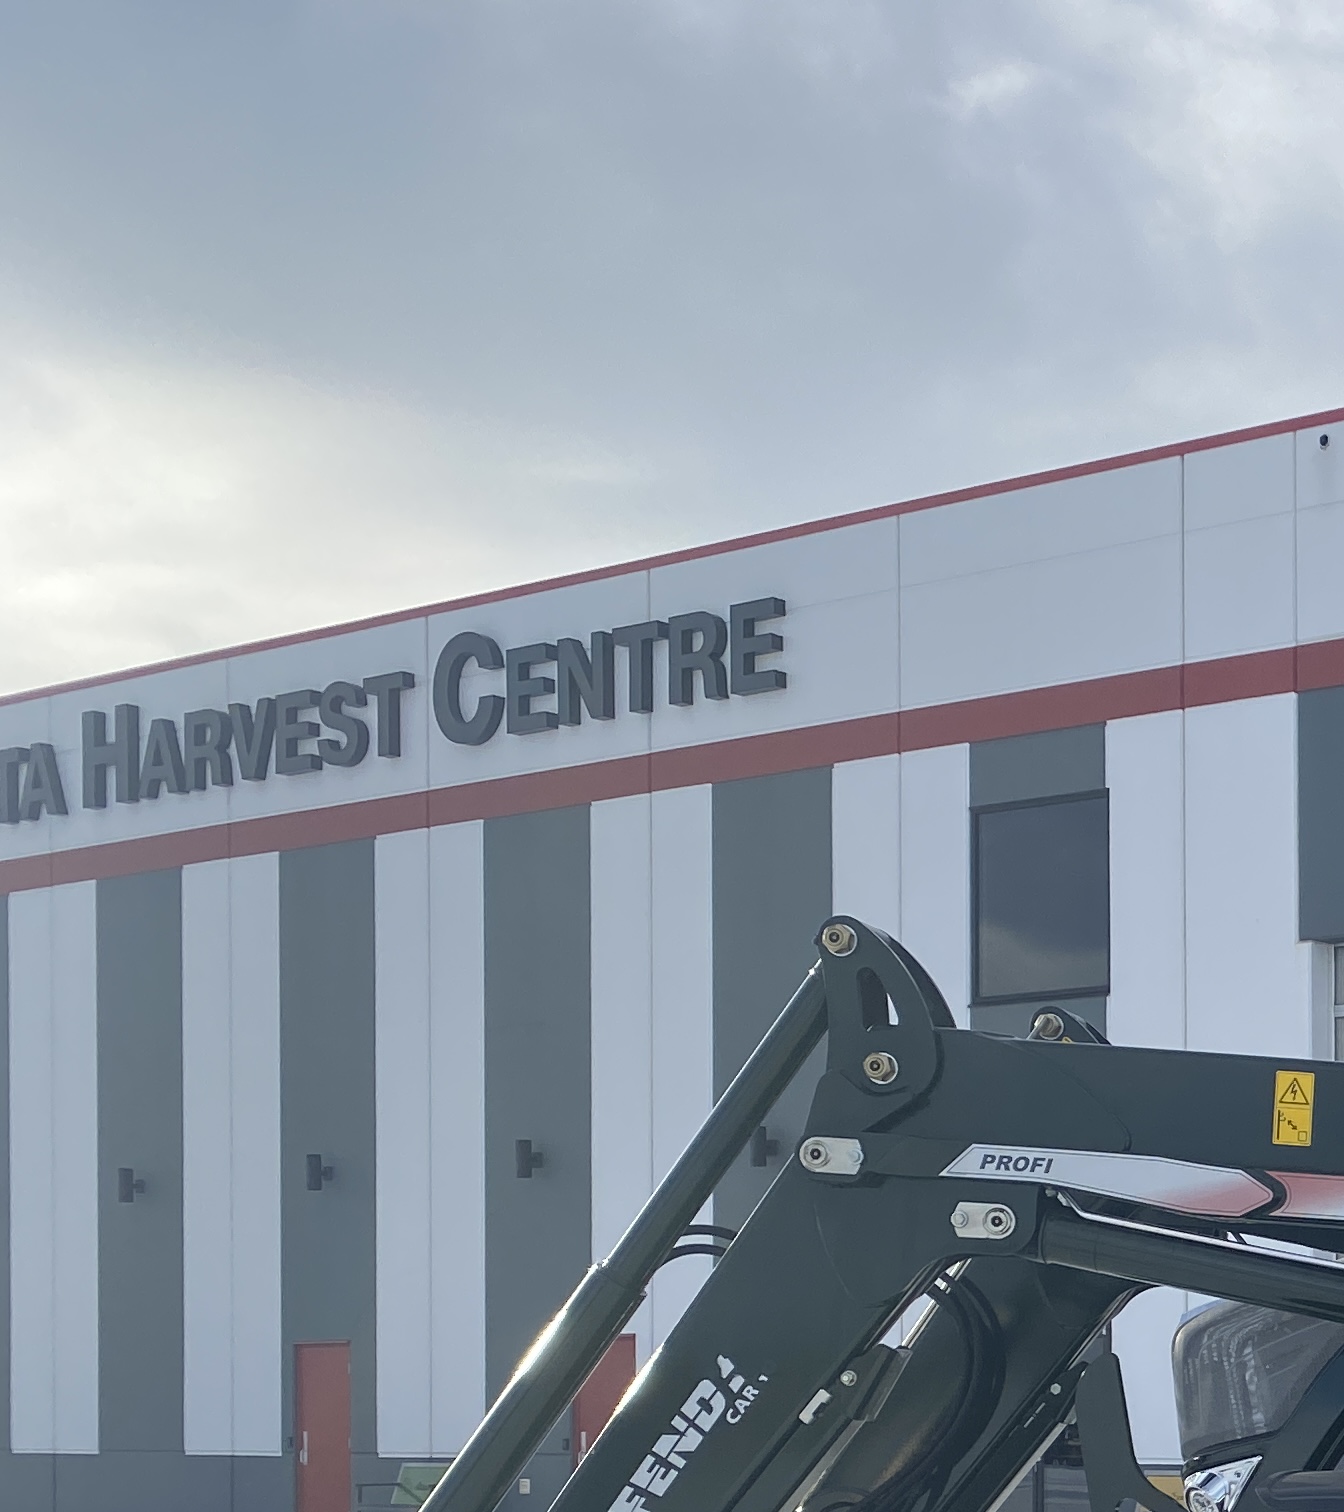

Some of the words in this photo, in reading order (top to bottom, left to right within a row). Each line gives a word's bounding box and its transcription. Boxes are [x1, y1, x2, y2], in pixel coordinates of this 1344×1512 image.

[82, 671, 415, 809] HARVEST
[433, 597, 787, 746] CENTRE
[979, 1153, 1054, 1174] PROFI
